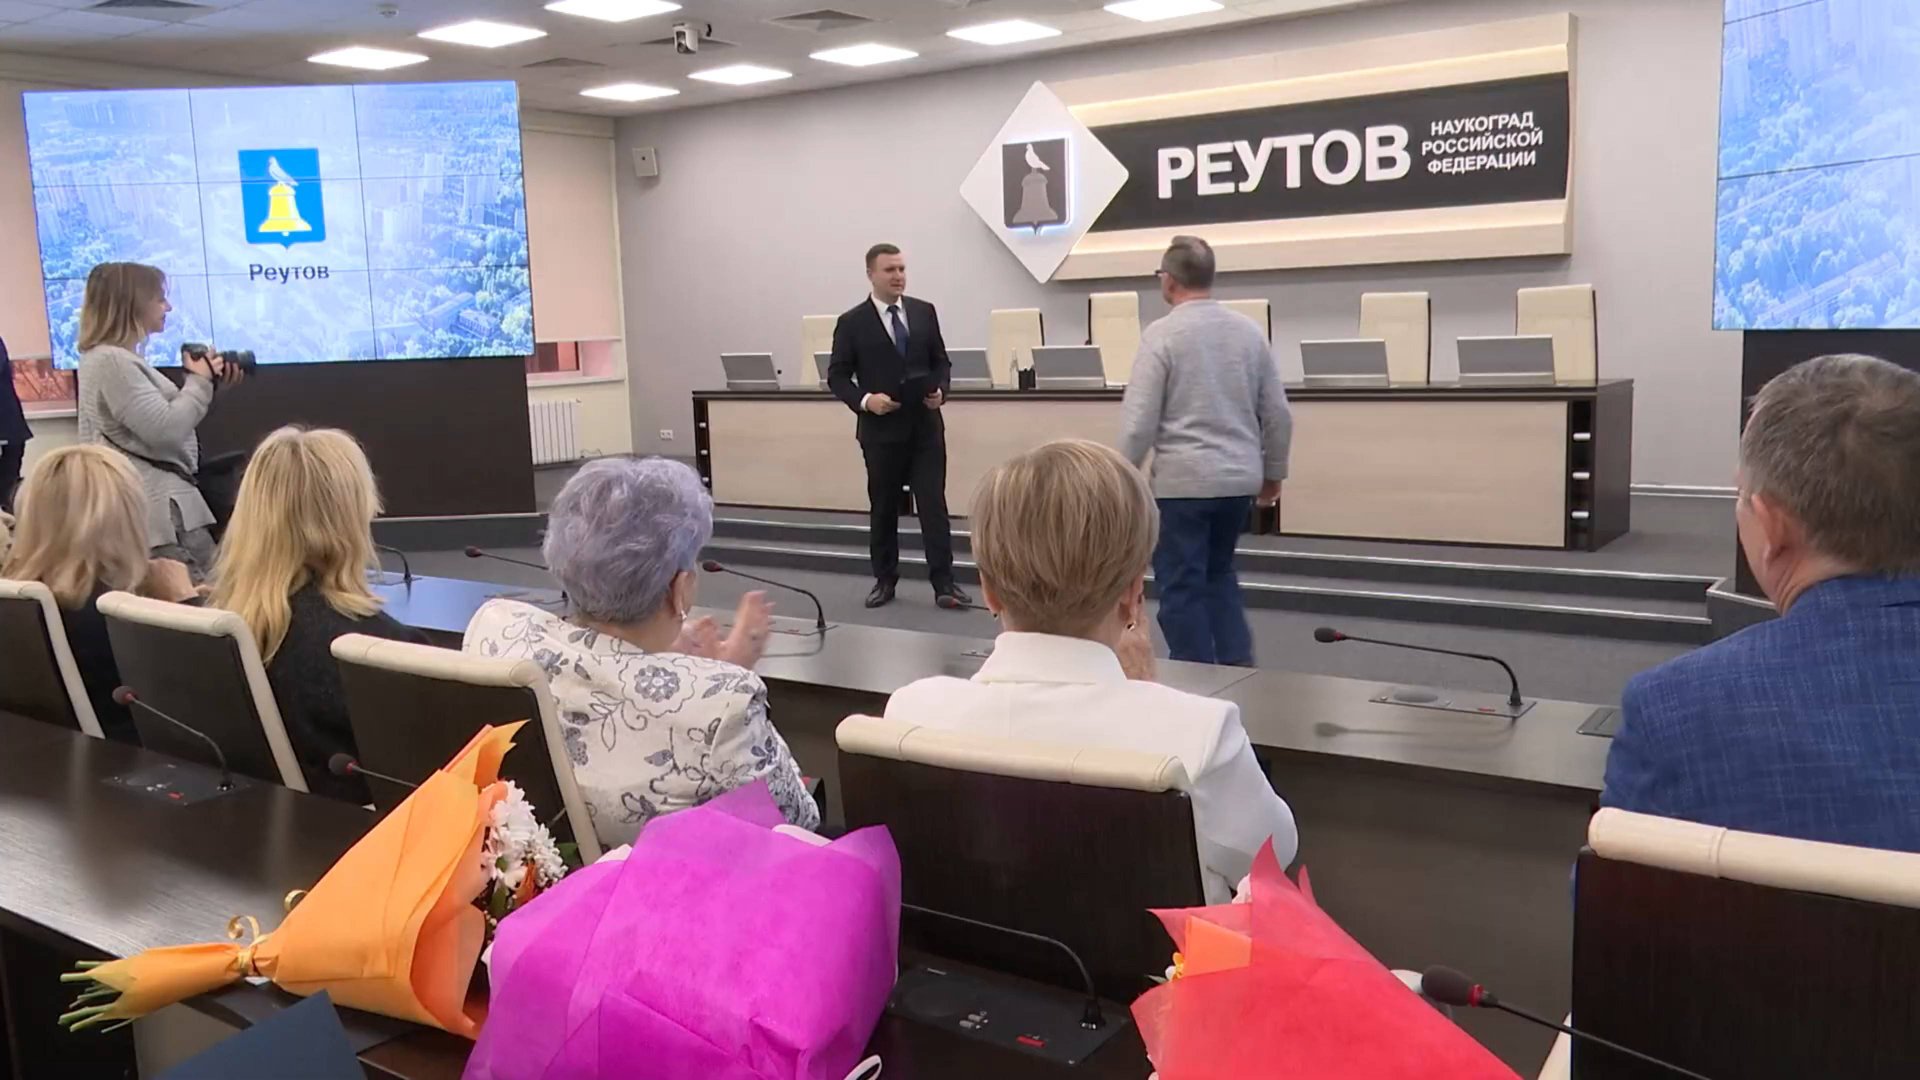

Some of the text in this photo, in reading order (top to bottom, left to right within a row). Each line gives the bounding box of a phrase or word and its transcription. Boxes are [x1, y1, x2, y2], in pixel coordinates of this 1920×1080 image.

[1430, 111, 1534, 136] НАУКОГРАД
[1421, 127, 1543, 156] РОССИЙСКОЙ
[1157, 124, 1411, 199] РЕУТОВ
[1427, 150, 1536, 175] ФЕДЕРАЦИИ
[249, 263, 329, 284] Реутов
